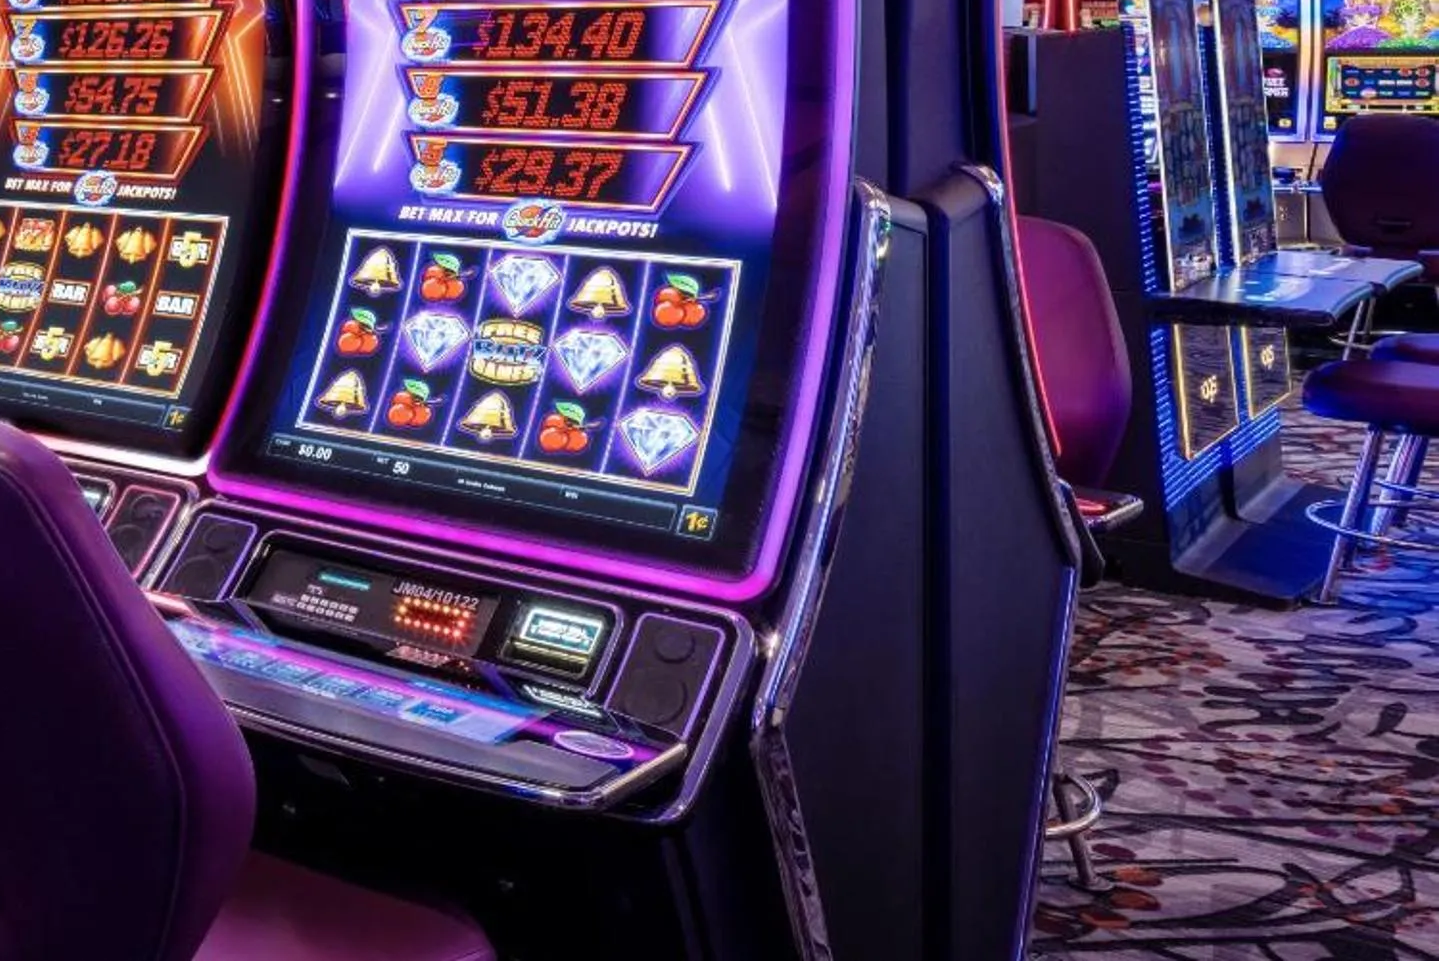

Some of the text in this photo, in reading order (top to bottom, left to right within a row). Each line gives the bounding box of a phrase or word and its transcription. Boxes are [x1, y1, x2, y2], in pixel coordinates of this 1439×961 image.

[471, 9, 645, 59] $134.40
[480, 79, 628, 130] $51.38
[473, 146, 624, 199] $29.37
[398, 205, 425, 221] BET
[428, 206, 468, 224] MAX
[468, 209, 499, 226] FOR
[566, 217, 659, 239] JACKPOTS!
[50, 282, 88, 303] BAR
[154, 294, 195, 315] BAR
[481, 320, 542, 345] FREE
[298, 444, 333, 461] $0.00
[392, 460, 410, 475] 50
[686, 511, 709, 532] 1¢
